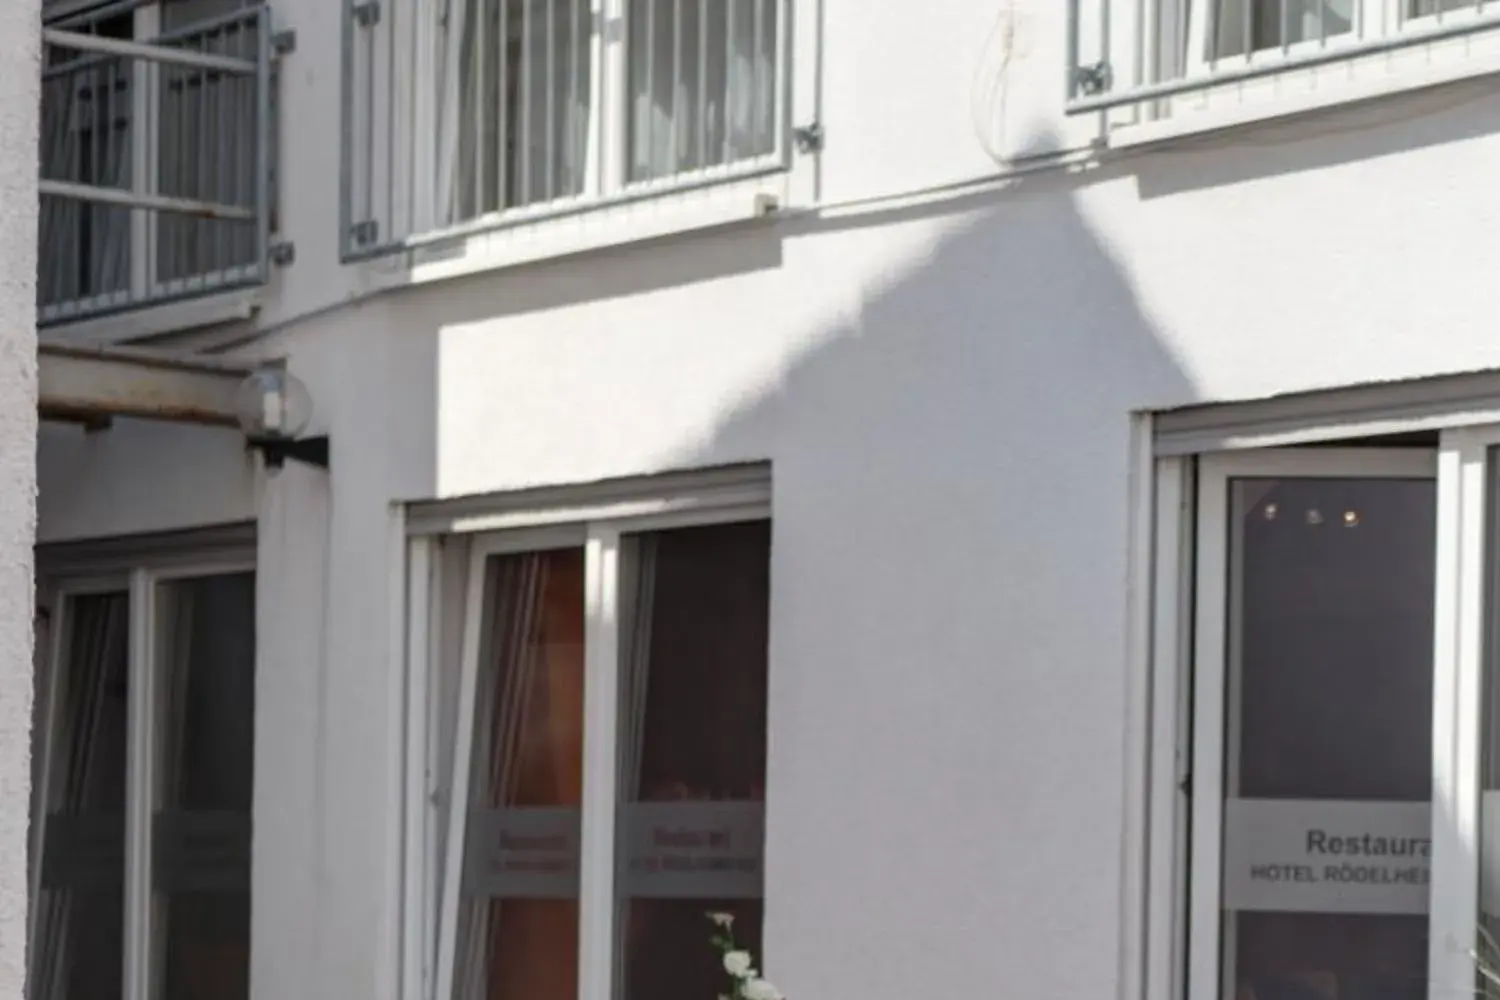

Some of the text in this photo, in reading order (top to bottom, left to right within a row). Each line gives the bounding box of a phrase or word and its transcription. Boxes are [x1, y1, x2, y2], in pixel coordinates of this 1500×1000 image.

[1306, 829, 1433, 857] Restaura
[1250, 861, 1432, 885] HOTEL RÖDELHEI
